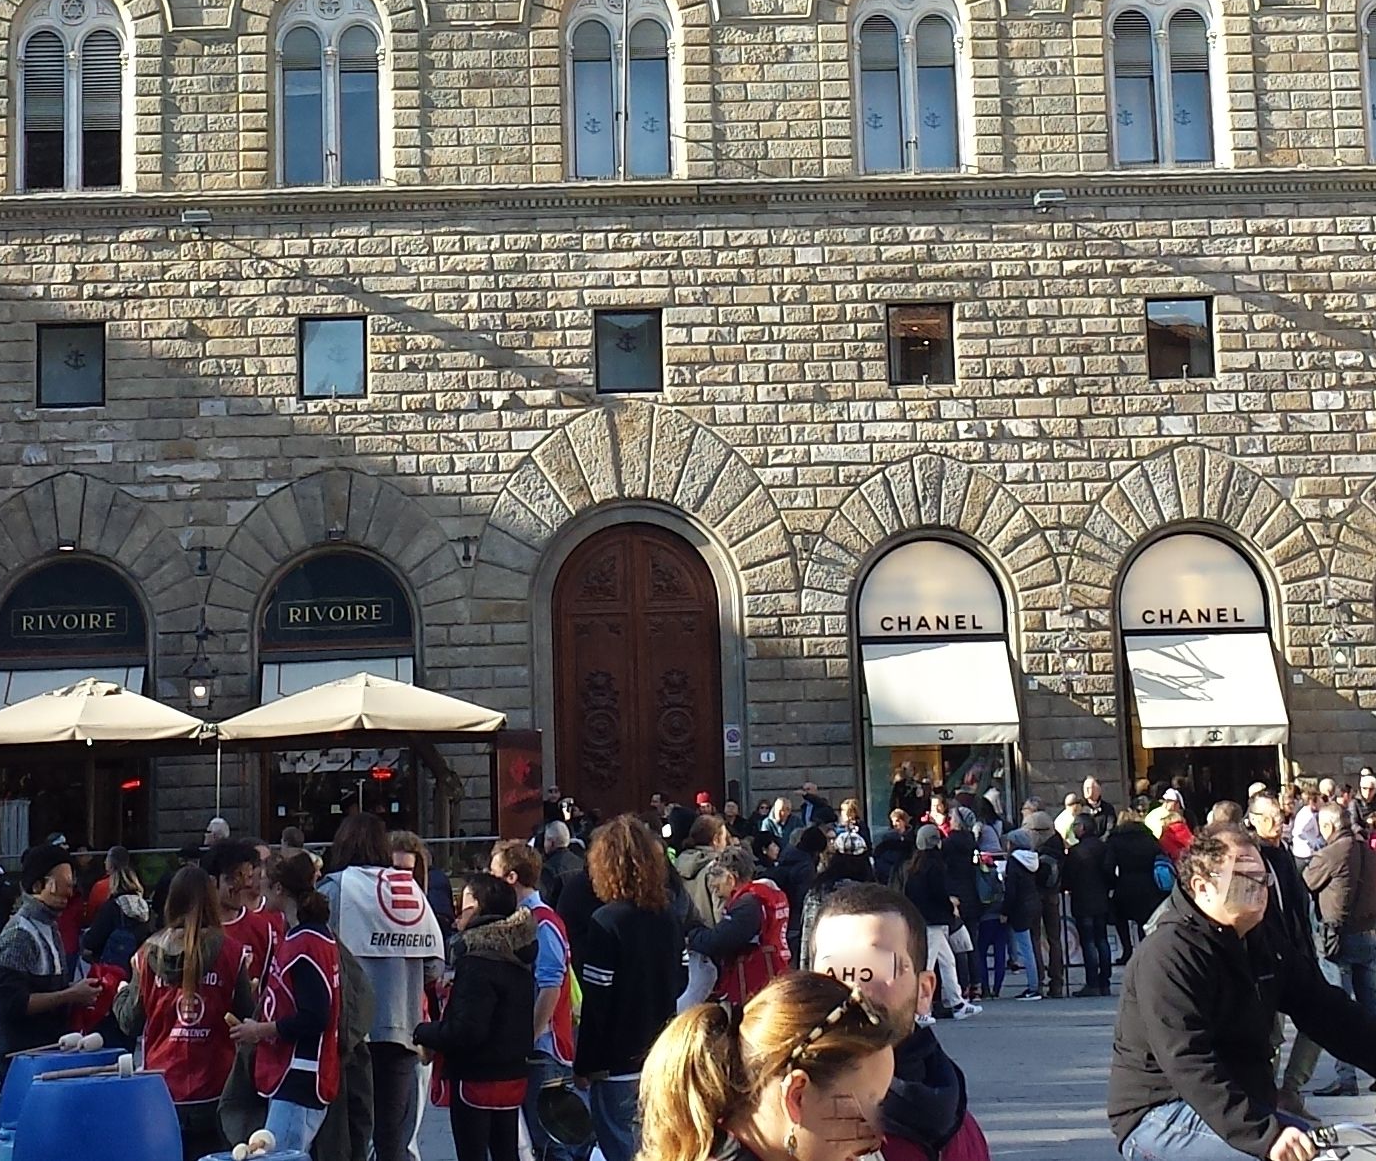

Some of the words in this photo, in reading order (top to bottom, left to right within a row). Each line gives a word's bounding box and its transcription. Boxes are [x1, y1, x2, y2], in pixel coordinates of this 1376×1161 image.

[22, 612, 116, 631] RIVOIRE
[287, 604, 382, 623] RIVOIRE
[880, 614, 983, 631] CHANEL
[1142, 607, 1245, 624] CHANEL
